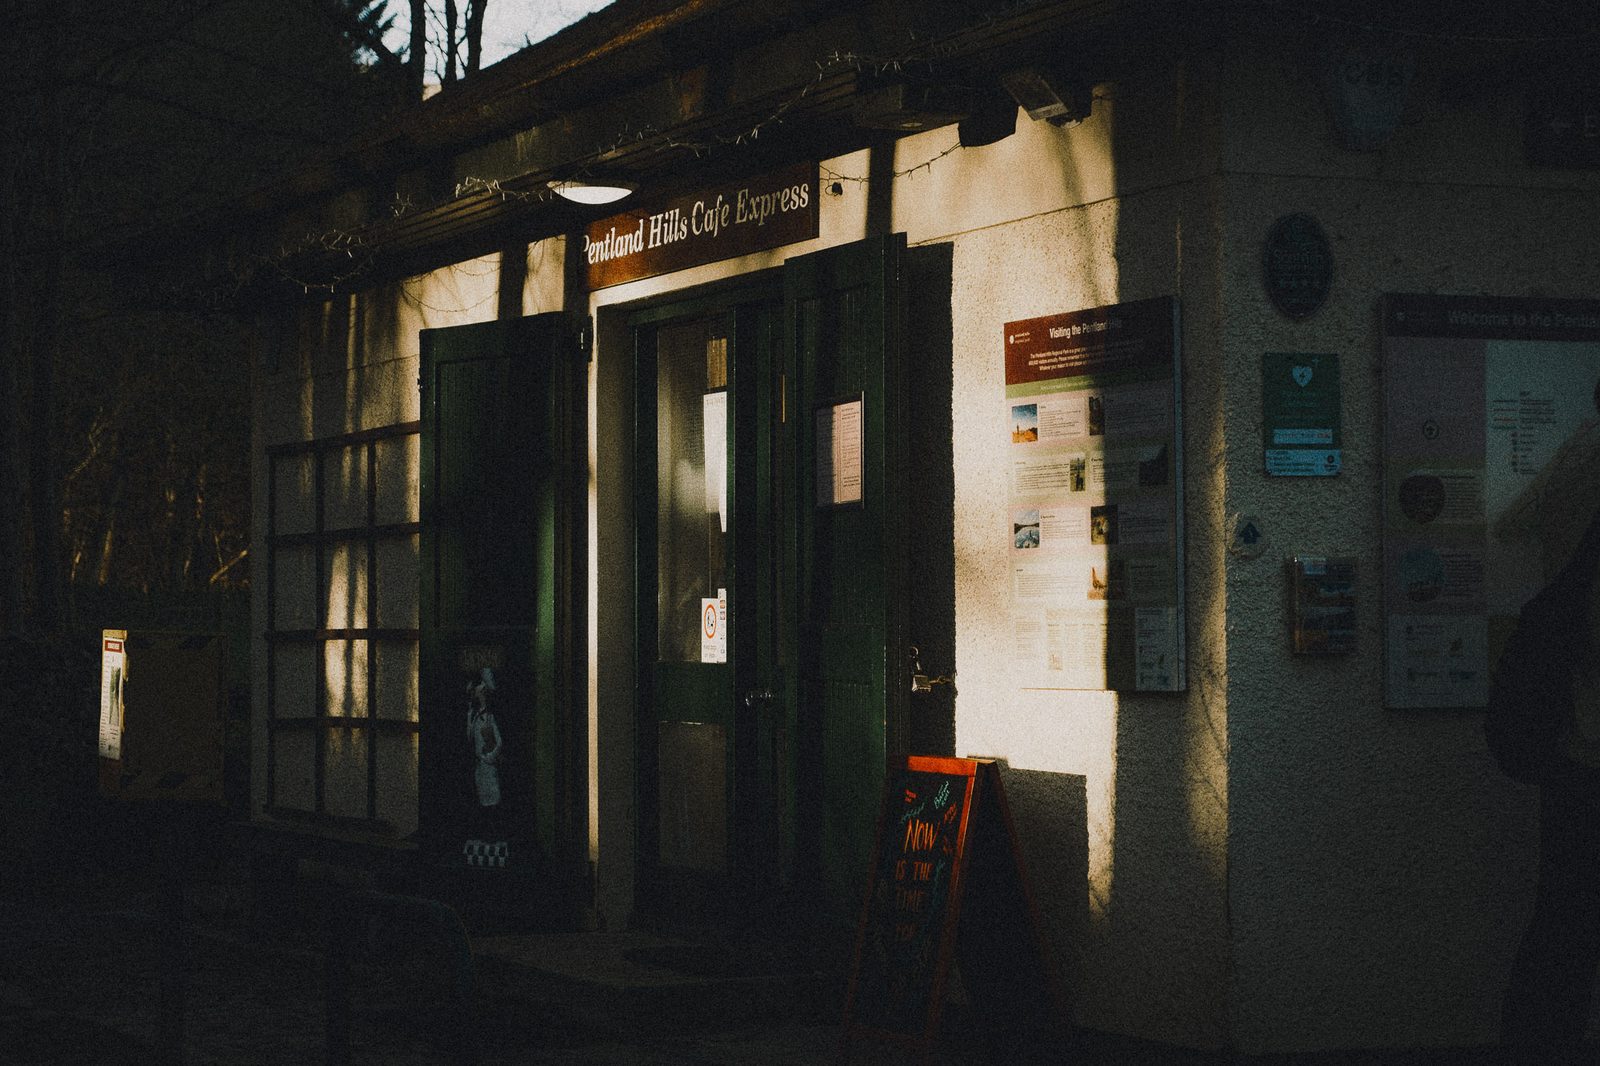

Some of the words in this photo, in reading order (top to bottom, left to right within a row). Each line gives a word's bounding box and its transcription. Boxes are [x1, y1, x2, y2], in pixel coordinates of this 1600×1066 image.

[647, 207, 688, 250] Hills
[691, 194, 731, 239] Cafe
[734, 182, 809, 226] Express
[1049, 326, 1071, 340] Visiting
[1071, 323, 1082, 336] the
[1447, 310, 1508, 326] Welcome
[1512, 311, 1527, 326] to
[1530, 312, 1551, 327] the
[904, 817, 941, 854] NOW
